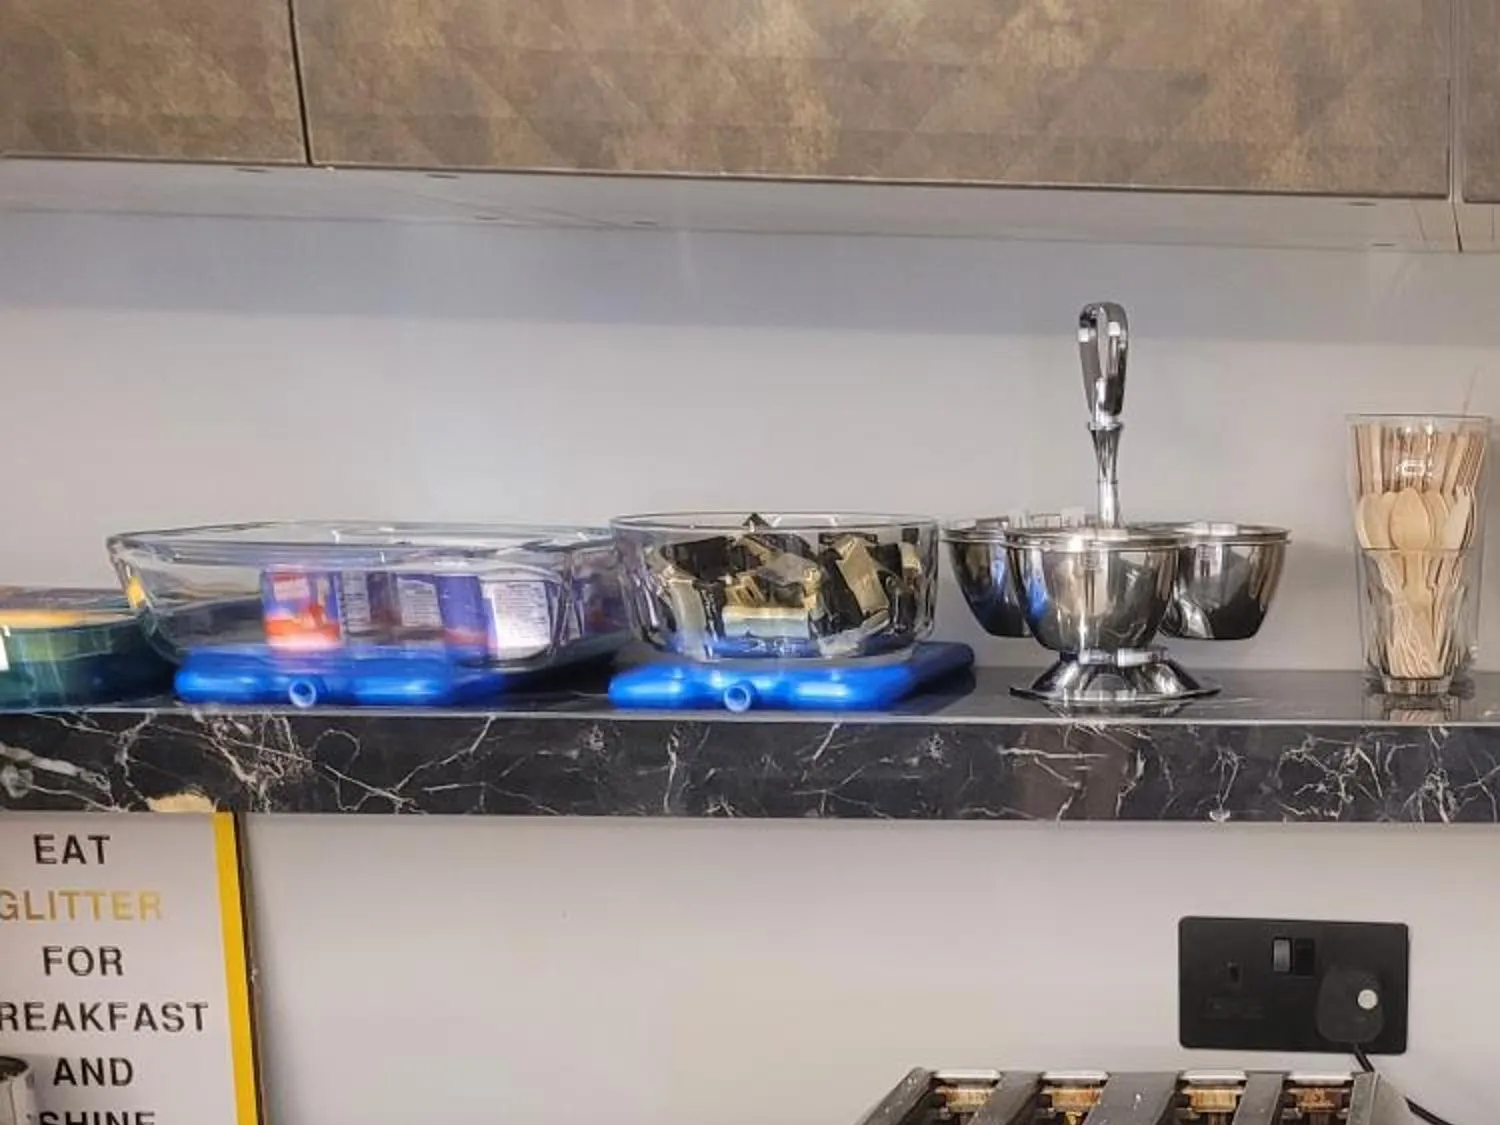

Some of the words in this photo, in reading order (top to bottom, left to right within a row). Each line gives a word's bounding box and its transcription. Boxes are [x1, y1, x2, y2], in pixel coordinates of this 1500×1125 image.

[33, 834, 110, 864] EAT
[0, 891, 162, 920] GLITTER
[43, 946, 124, 976] FOR
[0, 1002, 208, 1032] REAKFAST
[53, 1057, 133, 1086] AND
